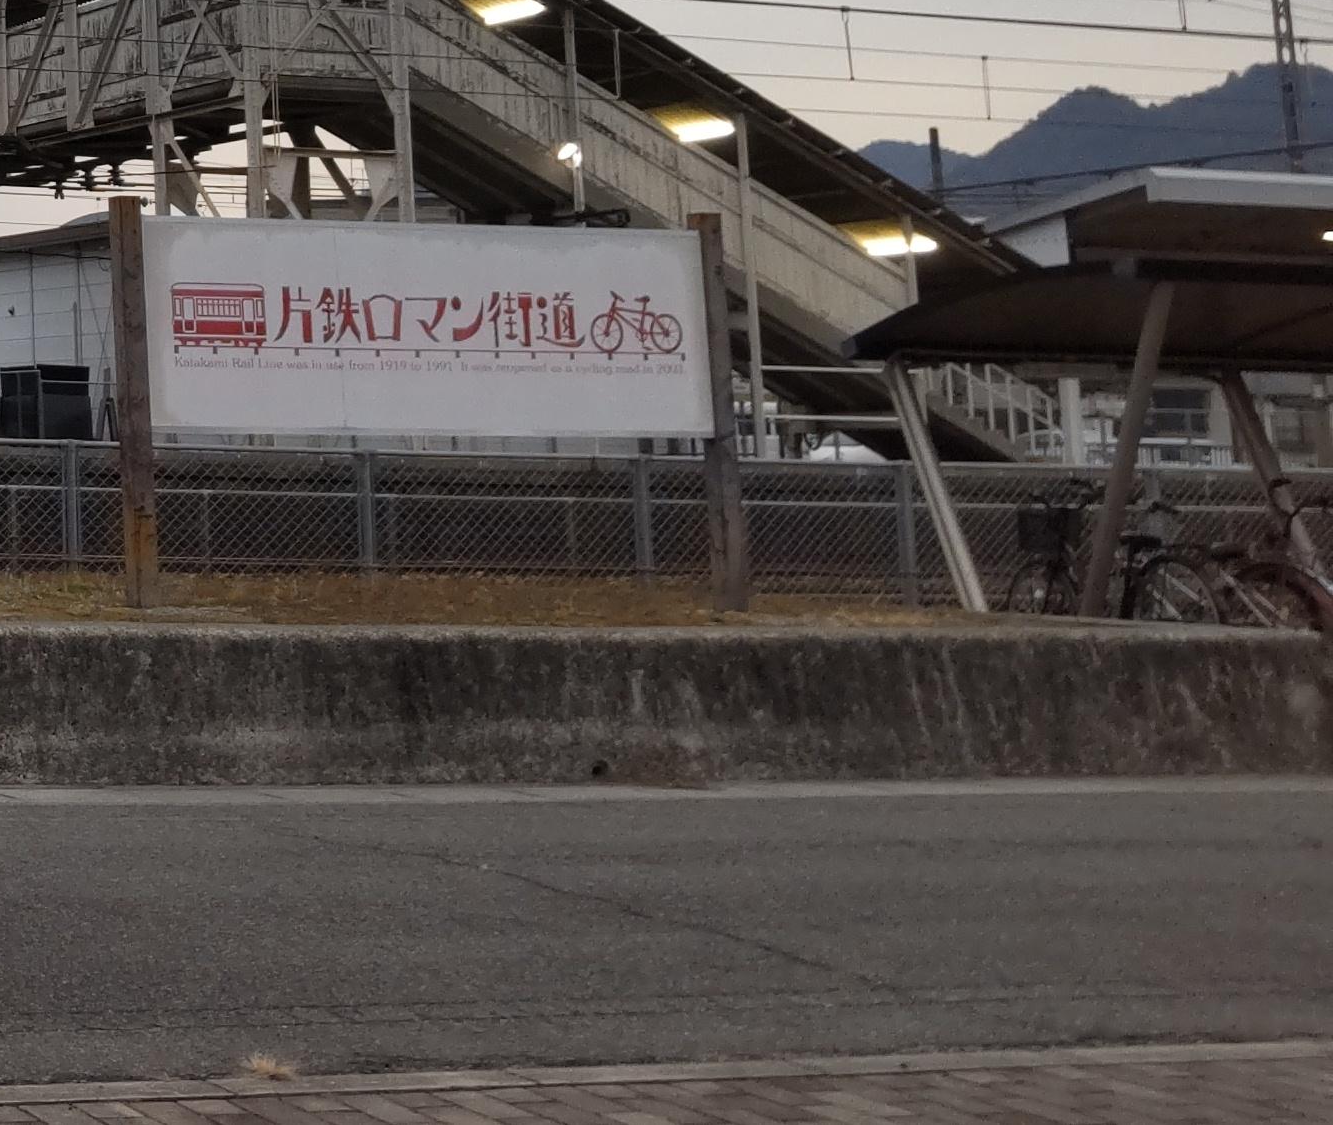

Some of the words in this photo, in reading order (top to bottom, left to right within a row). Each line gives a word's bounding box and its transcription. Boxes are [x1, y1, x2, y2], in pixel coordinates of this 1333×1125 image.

[273, 285, 586, 349] 片鉄ロマン街道
[174, 355, 228, 369] Katakami
[232, 356, 254, 370] Rail
[258, 357, 283, 370] Line
[286, 360, 309, 371] was
[311, 359, 322, 371] in
[326, 360, 345, 372] use
[349, 358, 375, 372] from
[410, 360, 422, 372] to
